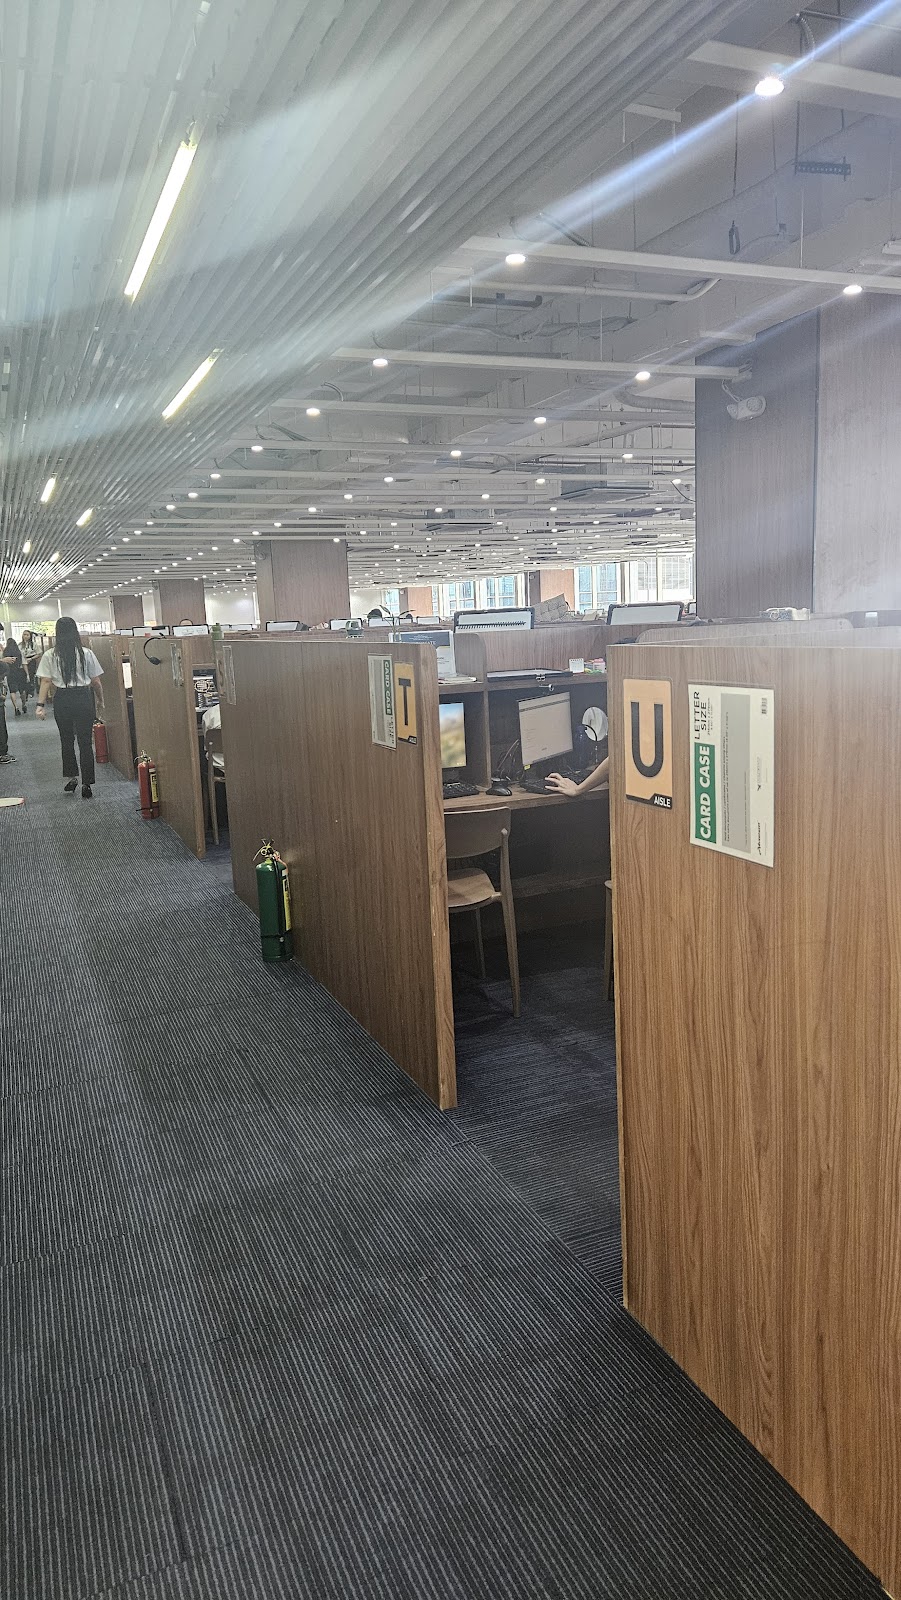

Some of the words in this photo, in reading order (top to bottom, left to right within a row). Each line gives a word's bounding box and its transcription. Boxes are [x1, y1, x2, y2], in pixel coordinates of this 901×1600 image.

[398, 678, 411, 725] T
[631, 702, 663, 777] U
[700, 746, 711, 788] CASE
[654, 796, 671, 808] AISLE
[700, 792, 711, 839] CARD
